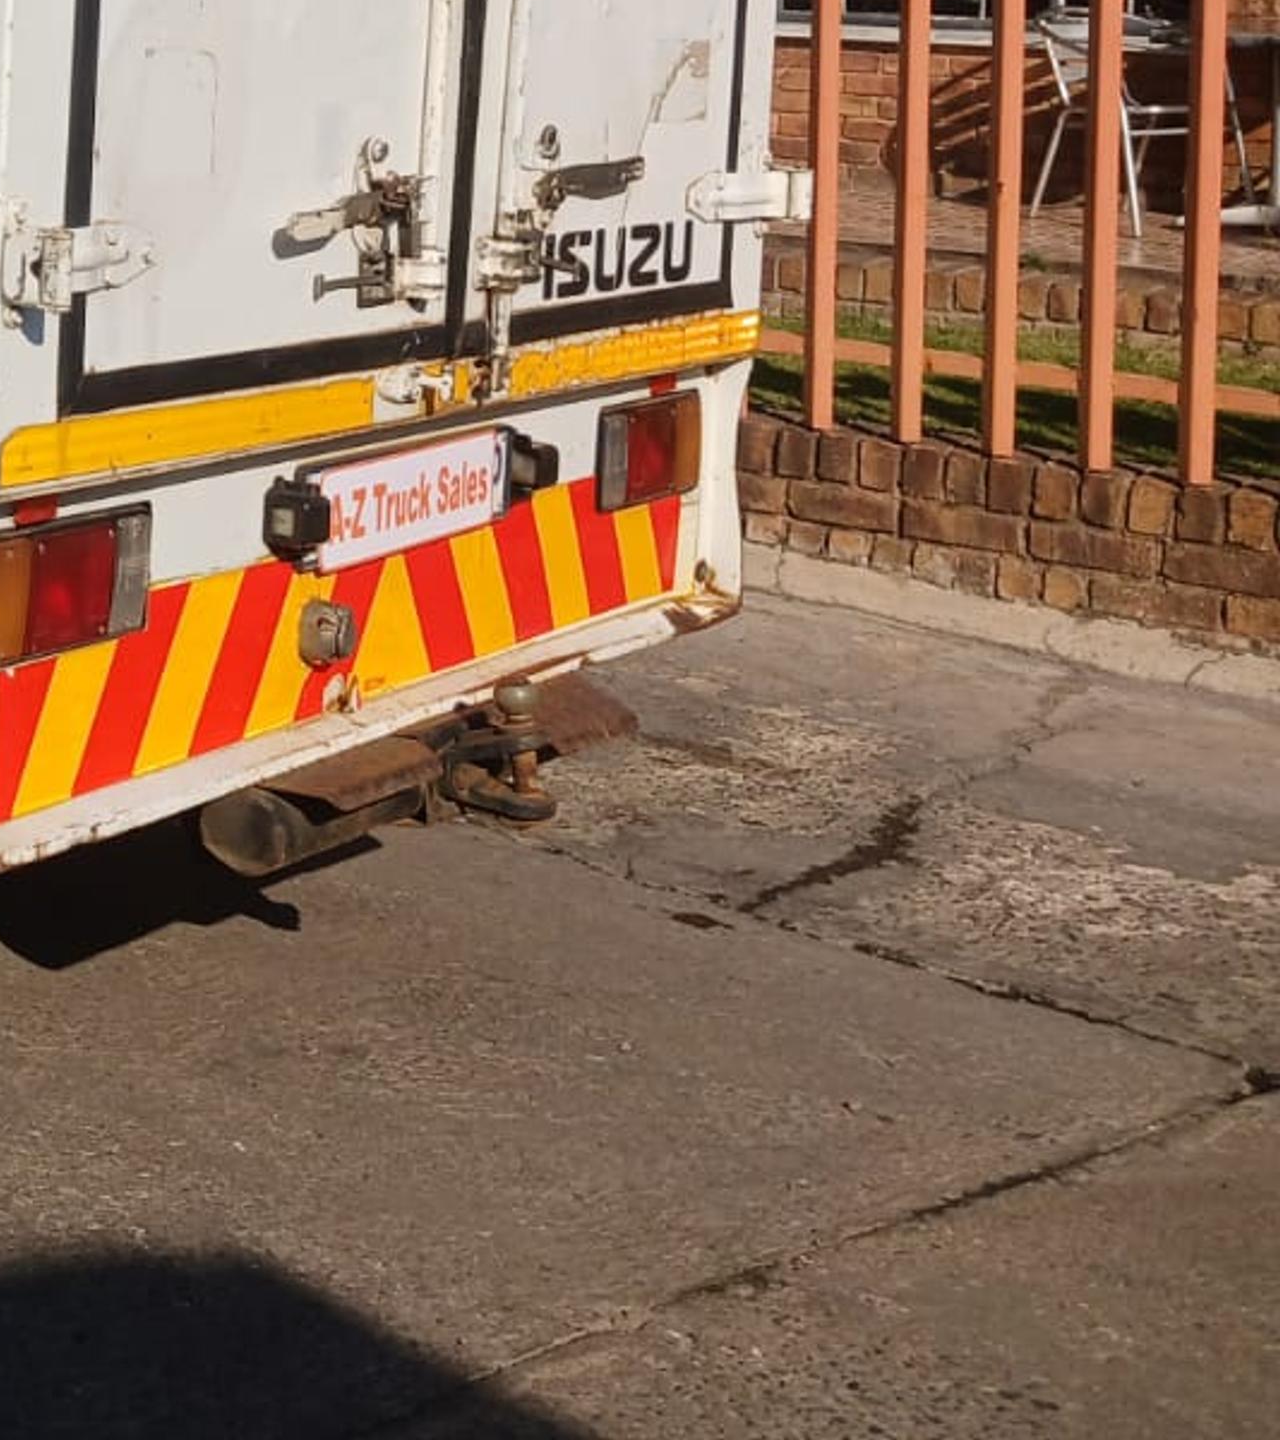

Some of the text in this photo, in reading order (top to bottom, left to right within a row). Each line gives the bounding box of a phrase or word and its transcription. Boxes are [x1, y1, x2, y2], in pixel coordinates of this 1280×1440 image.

[542, 219, 694, 301] ISUZU
[373, 471, 432, 532] Truck
[437, 460, 488, 514] Sales
